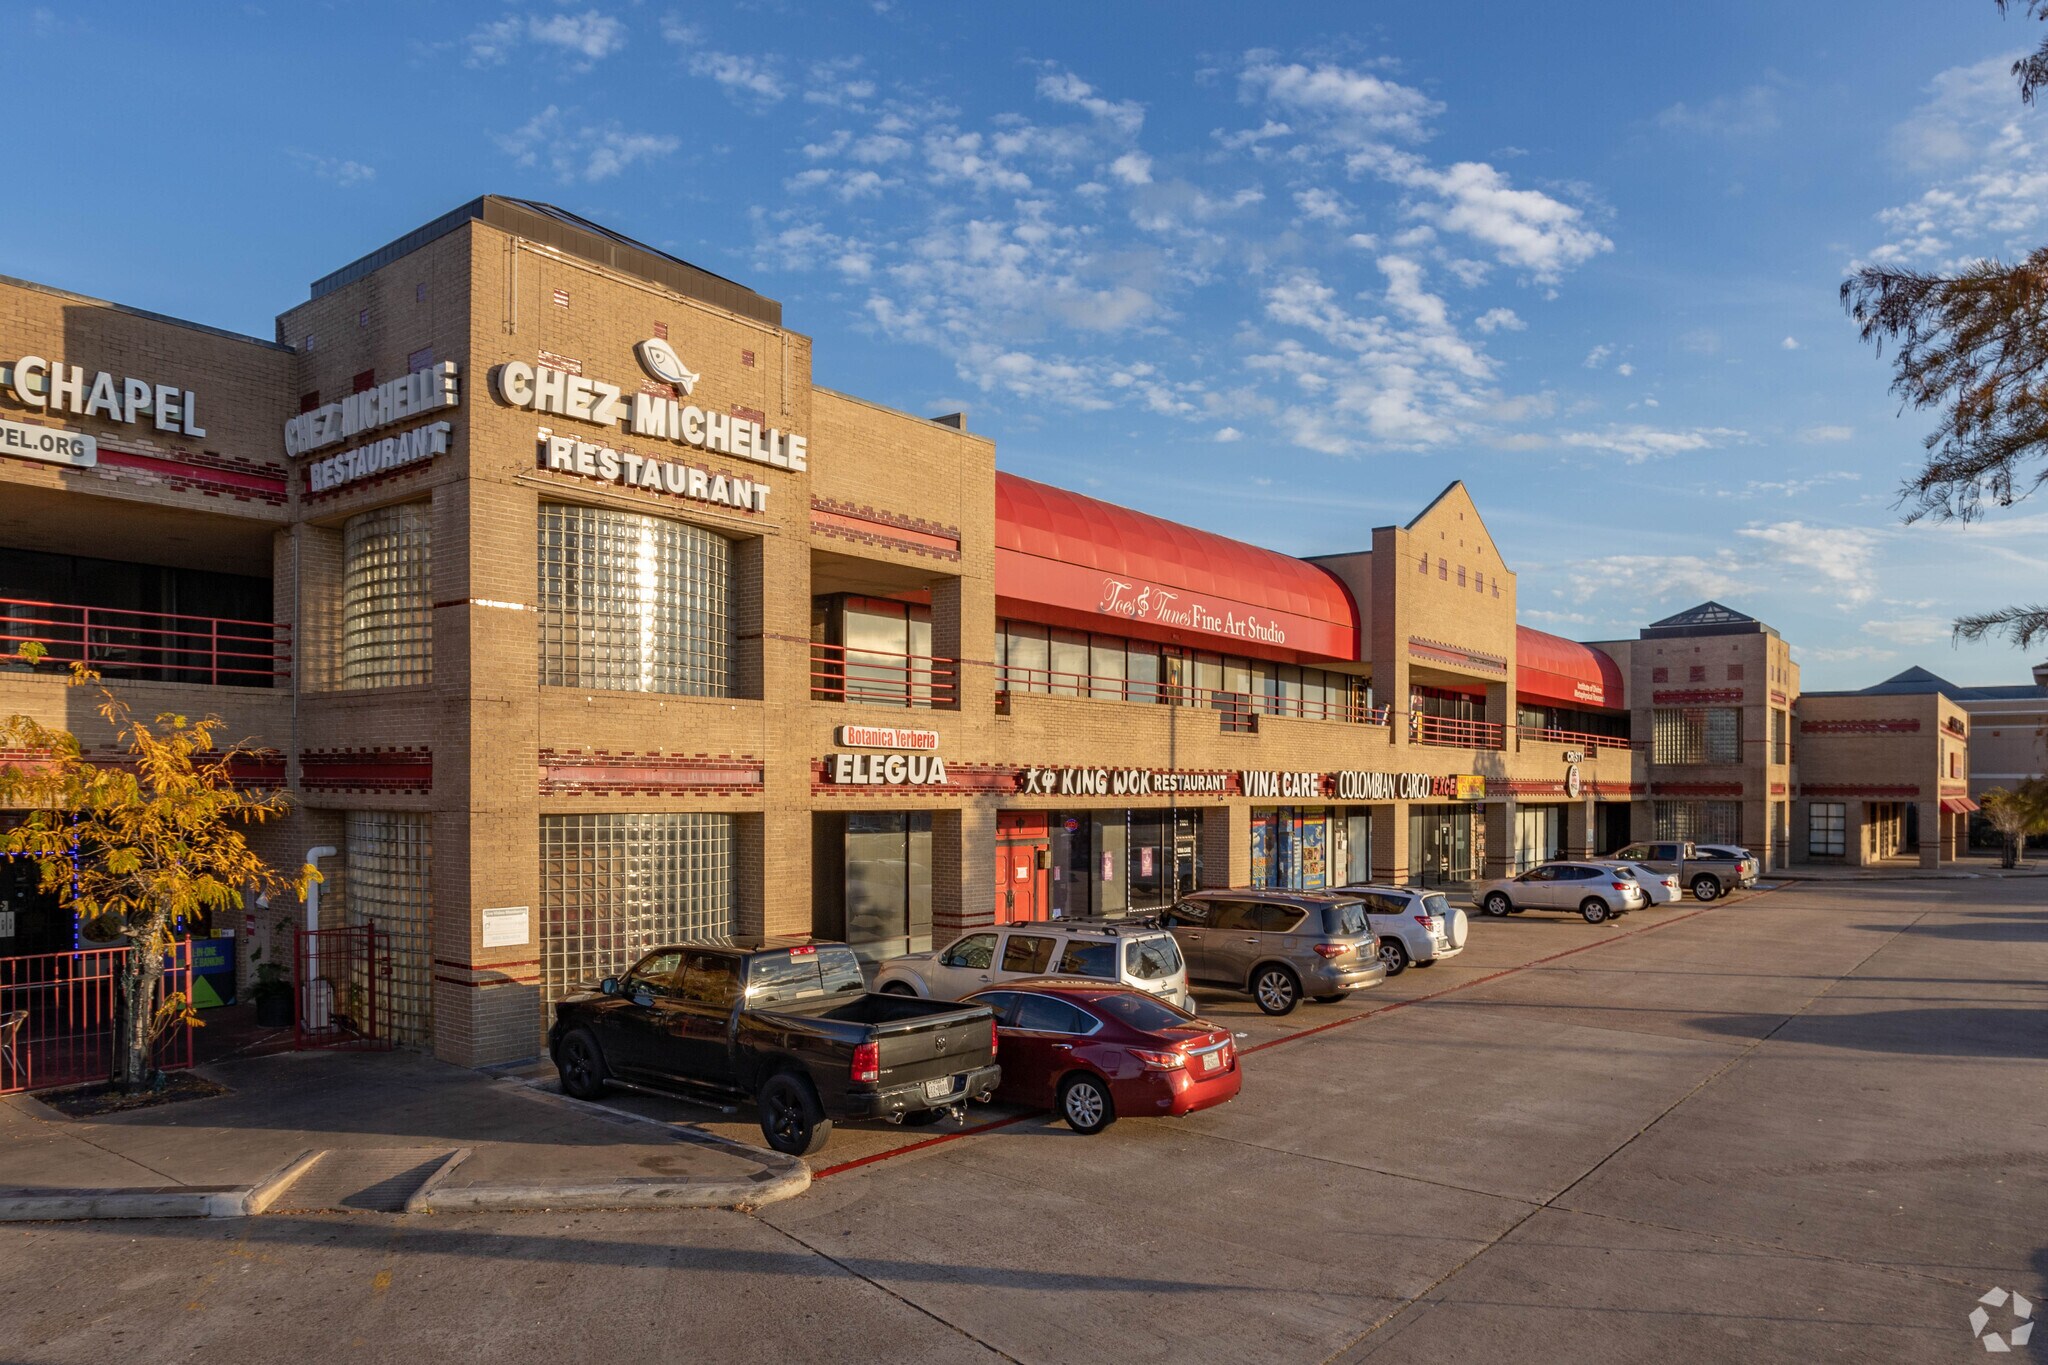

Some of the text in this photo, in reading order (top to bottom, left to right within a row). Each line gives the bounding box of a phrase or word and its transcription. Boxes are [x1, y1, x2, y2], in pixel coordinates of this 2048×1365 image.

[14, 355, 206, 438] CHAPEL
[284, 361, 459, 458] CHEZ MICHELLE
[499, 360, 807, 472] CHEZ MICHELLE
[0, 425, 85, 458] EL.ORG
[310, 420, 450, 492] RESTAURANT
[546, 434, 771, 513] RESTAURANT
[1152, 588, 1191, 627] Tunes
[1191, 604, 1222, 633] Fine
[1223, 611, 1246, 637] Art
[1248, 616, 1285, 645] Studio
[848, 726, 935, 749] Botanica Yerberia
[835, 754, 948, 784] ELEGUA
[1062, 769, 1227, 795] KING WOK RESTAURANT
[1243, 770, 1319, 797] VINA CARE
[1339, 770, 1430, 799] COLOMBIAN CARGO
